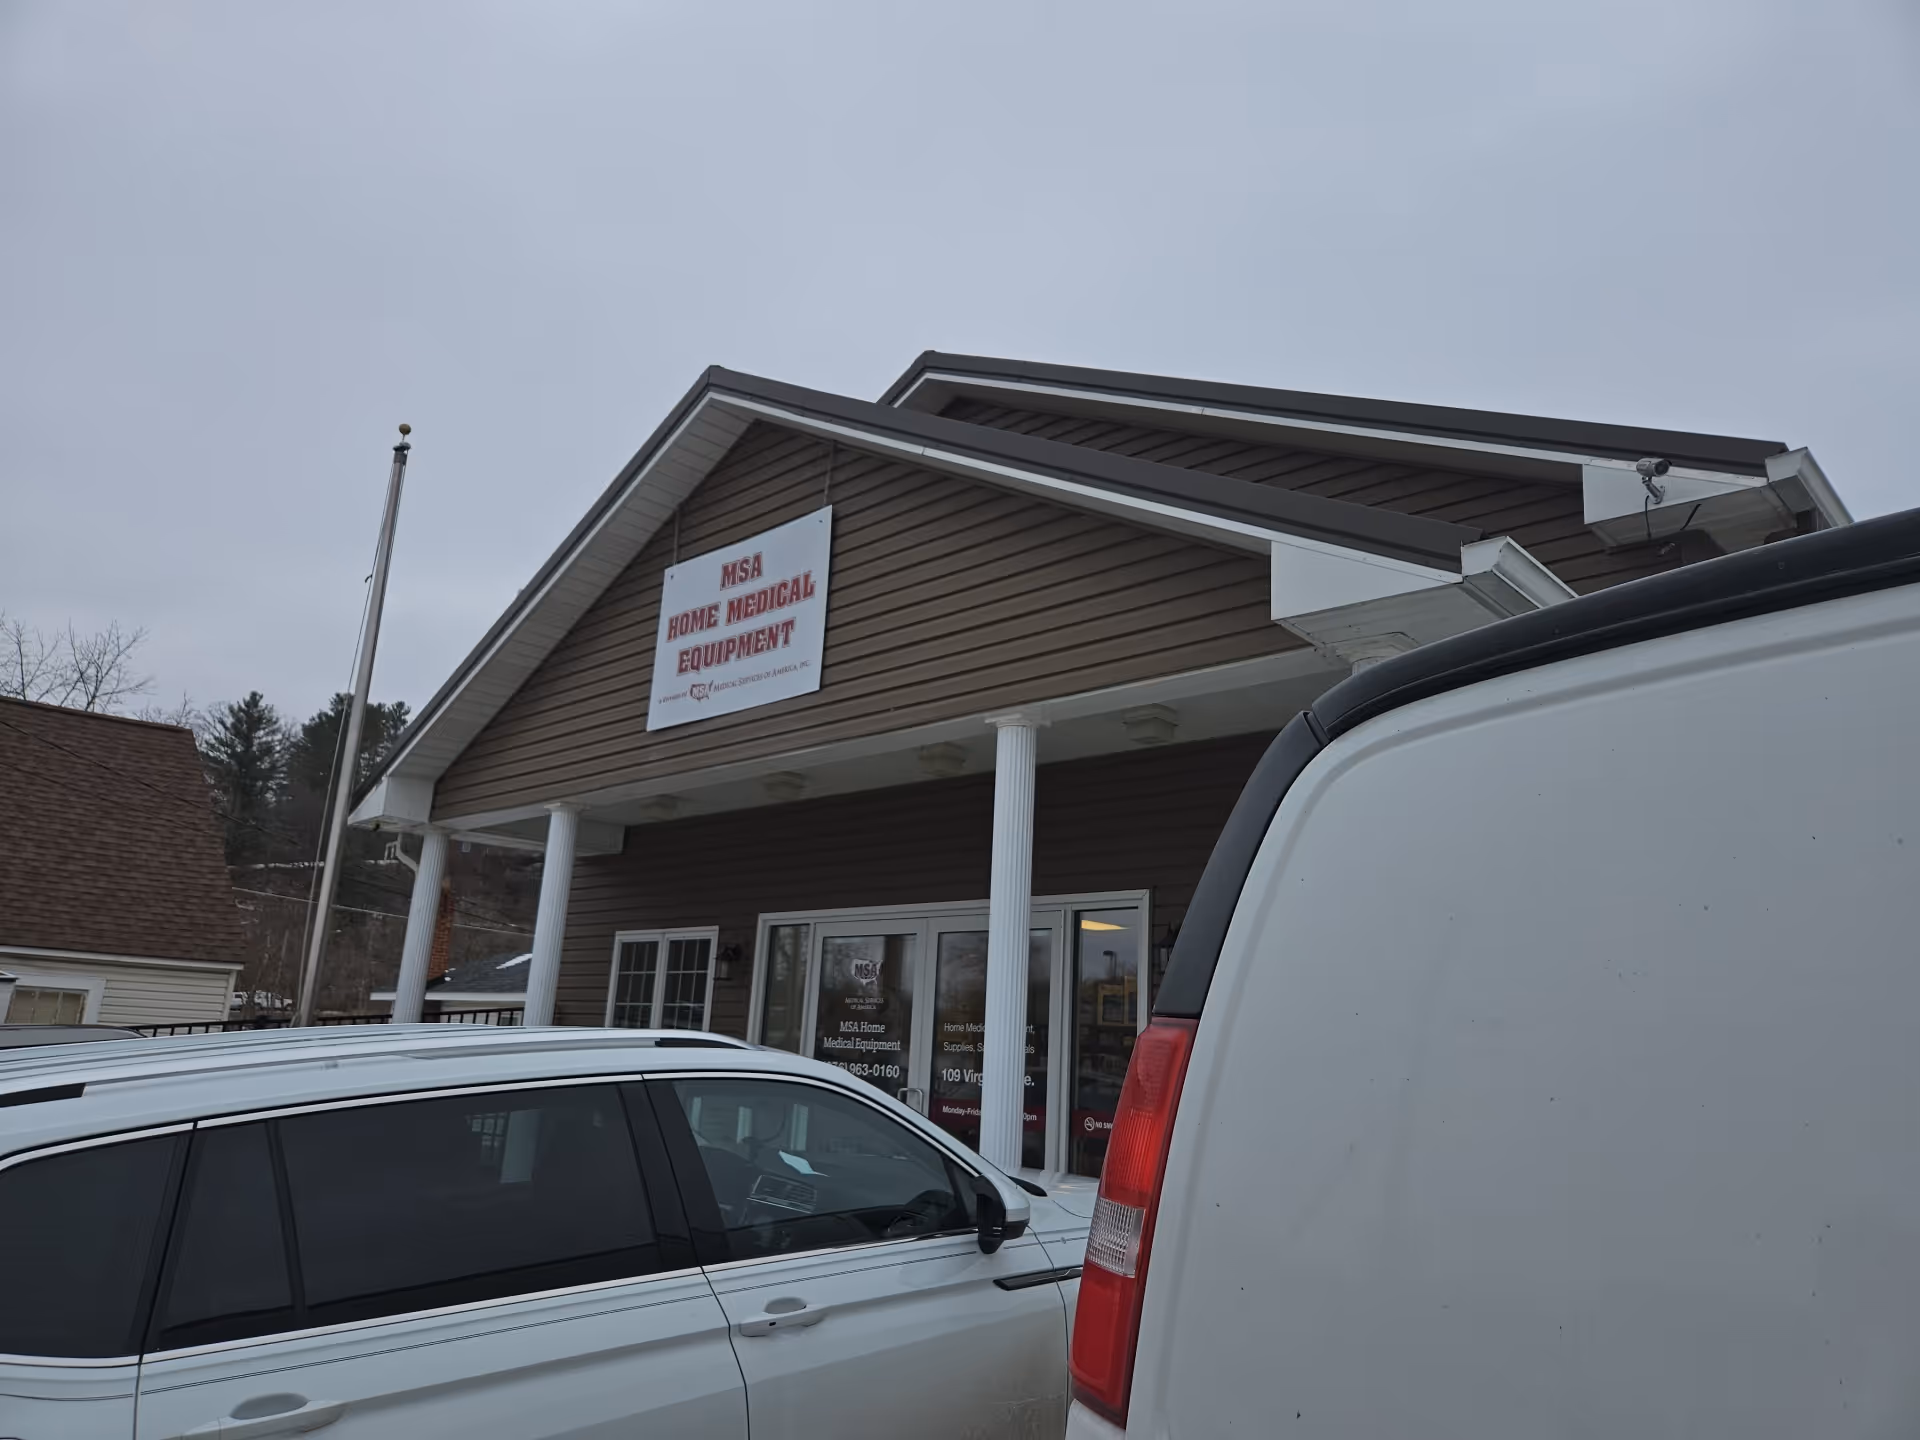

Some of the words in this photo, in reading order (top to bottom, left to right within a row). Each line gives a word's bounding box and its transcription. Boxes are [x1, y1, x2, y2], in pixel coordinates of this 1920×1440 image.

[720, 552, 763, 591] MSA
[666, 601, 721, 643] HOME
[725, 570, 816, 626] MEDICAL
[676, 617, 796, 676] EQUIPMENT
[854, 963, 878, 978] MSA
[840, 1021, 859, 1032] MSA
[860, 1021, 886, 1033] Home
[944, 1022, 964, 1032] Home
[965, 1022, 986, 1033] Medic
[823, 1036, 854, 1049] Medical
[855, 1037, 901, 1053] Equipment
[941, 1067, 961, 1082] 109
[963, 1068, 984, 1087] Virg
[1095, 1121, 1103, 1129] NO
